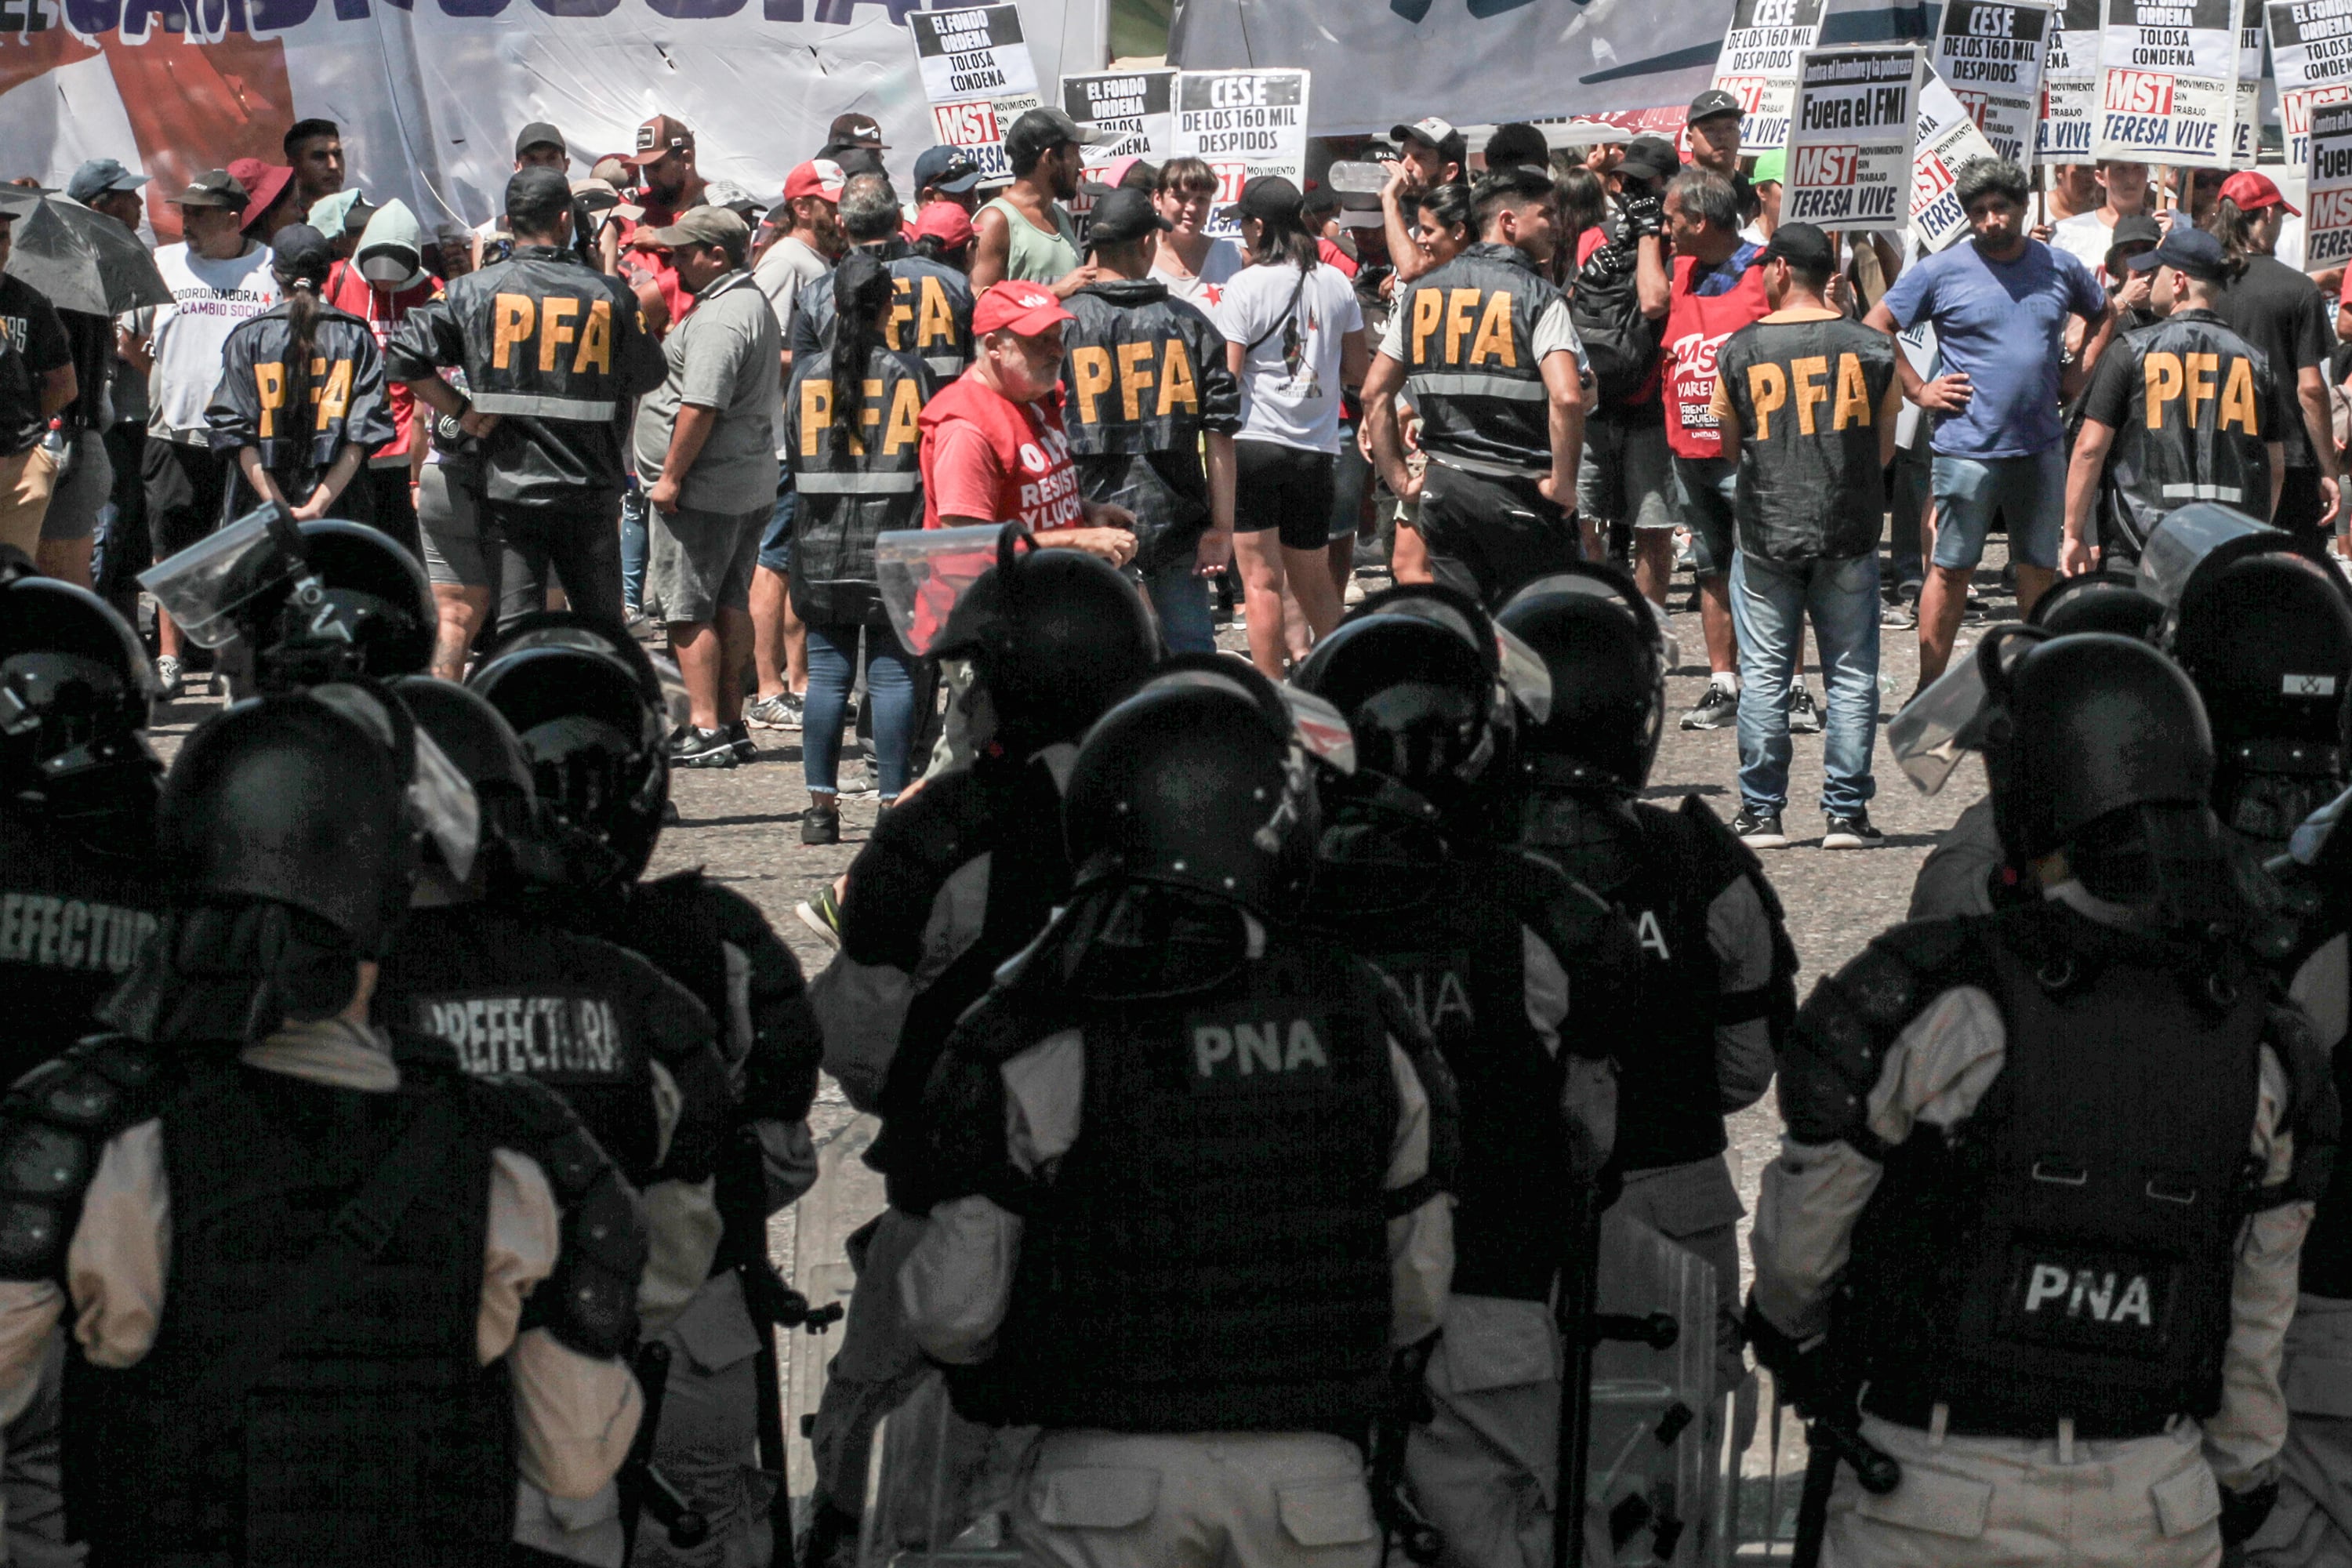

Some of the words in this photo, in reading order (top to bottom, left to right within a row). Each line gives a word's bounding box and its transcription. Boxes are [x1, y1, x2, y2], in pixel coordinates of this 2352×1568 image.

[931, 16, 948, 34] EL
[947, 9, 989, 33] FONDO
[1751, 0, 1799, 27] CESE
[1969, 6, 2016, 37] CESE
[2136, 6, 2194, 27] ORDENA
[2292, 5, 2309, 24] EL
[1727, 31, 1743, 50] DE
[1743, 30, 1765, 49] LOS
[1766, 29, 1788, 47] 160
[1790, 28, 1812, 46] MIL
[2140, 28, 2190, 47] TOLOSA
[2299, 15, 2352, 42] ORDENA
[940, 29, 992, 53] ORDENA
[1944, 37, 1958, 56] DE
[1961, 38, 1983, 58] LOS
[1986, 39, 2009, 60] 160
[2013, 42, 2035, 62] MIL
[949, 51, 995, 71] TOLOSA
[1733, 50, 1793, 71] DESPIDOS
[2132, 48, 2195, 67] CONDENA
[950, 70, 1006, 92] CONDENA
[1953, 60, 2018, 83] DESPIDOS
[1087, 84, 1102, 100] EL
[1103, 77, 1146, 98] FONDO
[1211, 77, 1267, 108] CESE
[2106, 71, 2172, 114] MST
[2174, 93, 2187, 101] SIN
[2175, 79, 2225, 93] MOVIMIENTO
[993, 99, 1037, 111] MOVIMIENTO
[1092, 100, 1145, 119] ORDENA
[1801, 93, 1852, 130] Fuera
[1855, 88, 1871, 127] el
[1874, 86, 1907, 125] FMI
[1952, 91, 1987, 130] ST
[1987, 96, 2031, 110] MOVIMIENTO
[2050, 96, 2063, 104] SIN
[2173, 105, 2206, 117] TRABAJO
[938, 103, 994, 145] MST
[996, 117, 1009, 125] SIN
[1182, 114, 1201, 132] DE
[1206, 112, 1231, 131] LOS
[1236, 109, 1265, 129] 160
[1270, 107, 1298, 127] MIL
[1986, 109, 1998, 119] SIN
[2050, 108, 2082, 117] TRABAJO
[1756, 118, 1791, 143] VIVE
[1934, 124, 1973, 155] MOVIMIENTO
[1984, 122, 2014, 135] TRABAJO
[2056, 122, 2092, 148] VIVE
[2103, 114, 2169, 145] TERESA
[2175, 120, 2218, 149] VIVE
[1199, 131, 1278, 154] DESPIDOS
[1859, 146, 1904, 156] MOVIMIENTO
[1247, 166, 1296, 176] MOVIMIENTO
[1795, 147, 1857, 185] MST
[1857, 160, 1870, 169] SIN
[1943, 155, 1955, 167] SIN
[1212, 164, 1245, 201] ST
[1856, 172, 1887, 182] TRABAJO
[1791, 187, 1853, 217] TERESA
[1858, 186, 1897, 214] VIVE
[182, 302, 227, 317] CAMBIO
[886, 276, 956, 351] FA
[492, 292, 611, 375] PFA
[1413, 287, 1517, 368] PFA
[1072, 338, 1199, 425] PFA
[1748, 352, 1871, 441] PFA
[2144, 352, 2258, 436] PFA
[1193, 1018, 1328, 1078] PNA
[2024, 1262, 2151, 1327] PNA
